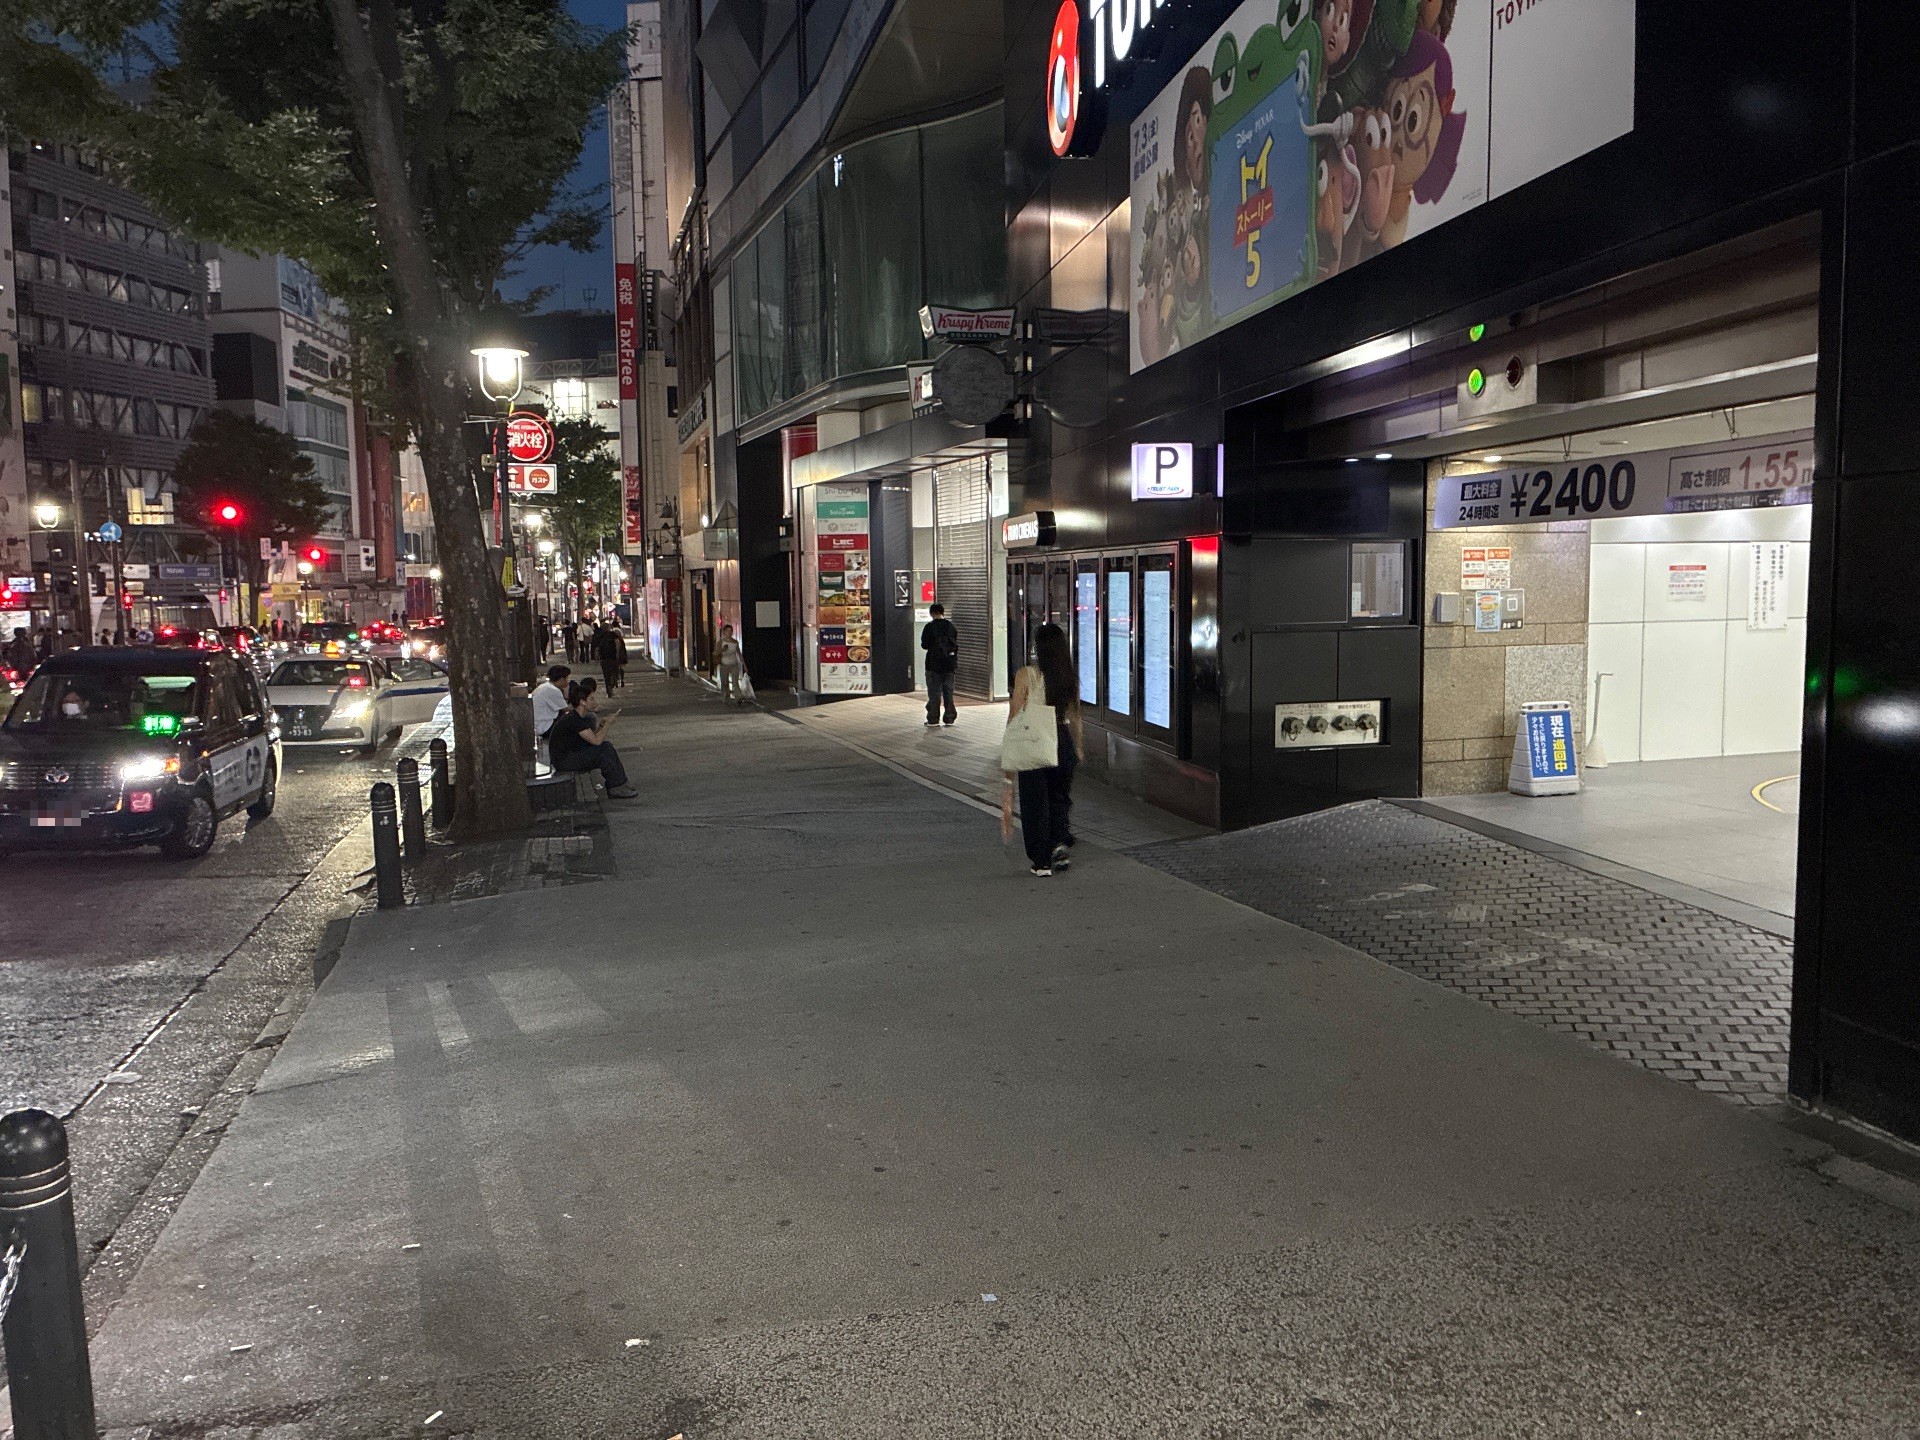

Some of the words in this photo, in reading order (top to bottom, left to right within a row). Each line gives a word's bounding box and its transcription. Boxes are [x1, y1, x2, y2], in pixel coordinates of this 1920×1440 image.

[1237, 199, 1272, 235] ストーリー
[1246, 229, 1261, 288] 5
[619, 278, 632, 305] 免税
[937, 313, 975, 332] Krispy
[975, 315, 1011, 330] Kreme
[619, 318, 633, 386] TaxFree
[507, 431, 543, 449] 消火栓
[1155, 446, 1179, 484] P
[1680, 467, 1731, 490] 高さ制限
[1464, 482, 1499, 499] 最大料金
[1510, 460, 1636, 517] ¥2400
[1459, 504, 1500, 521] 24時間迄
